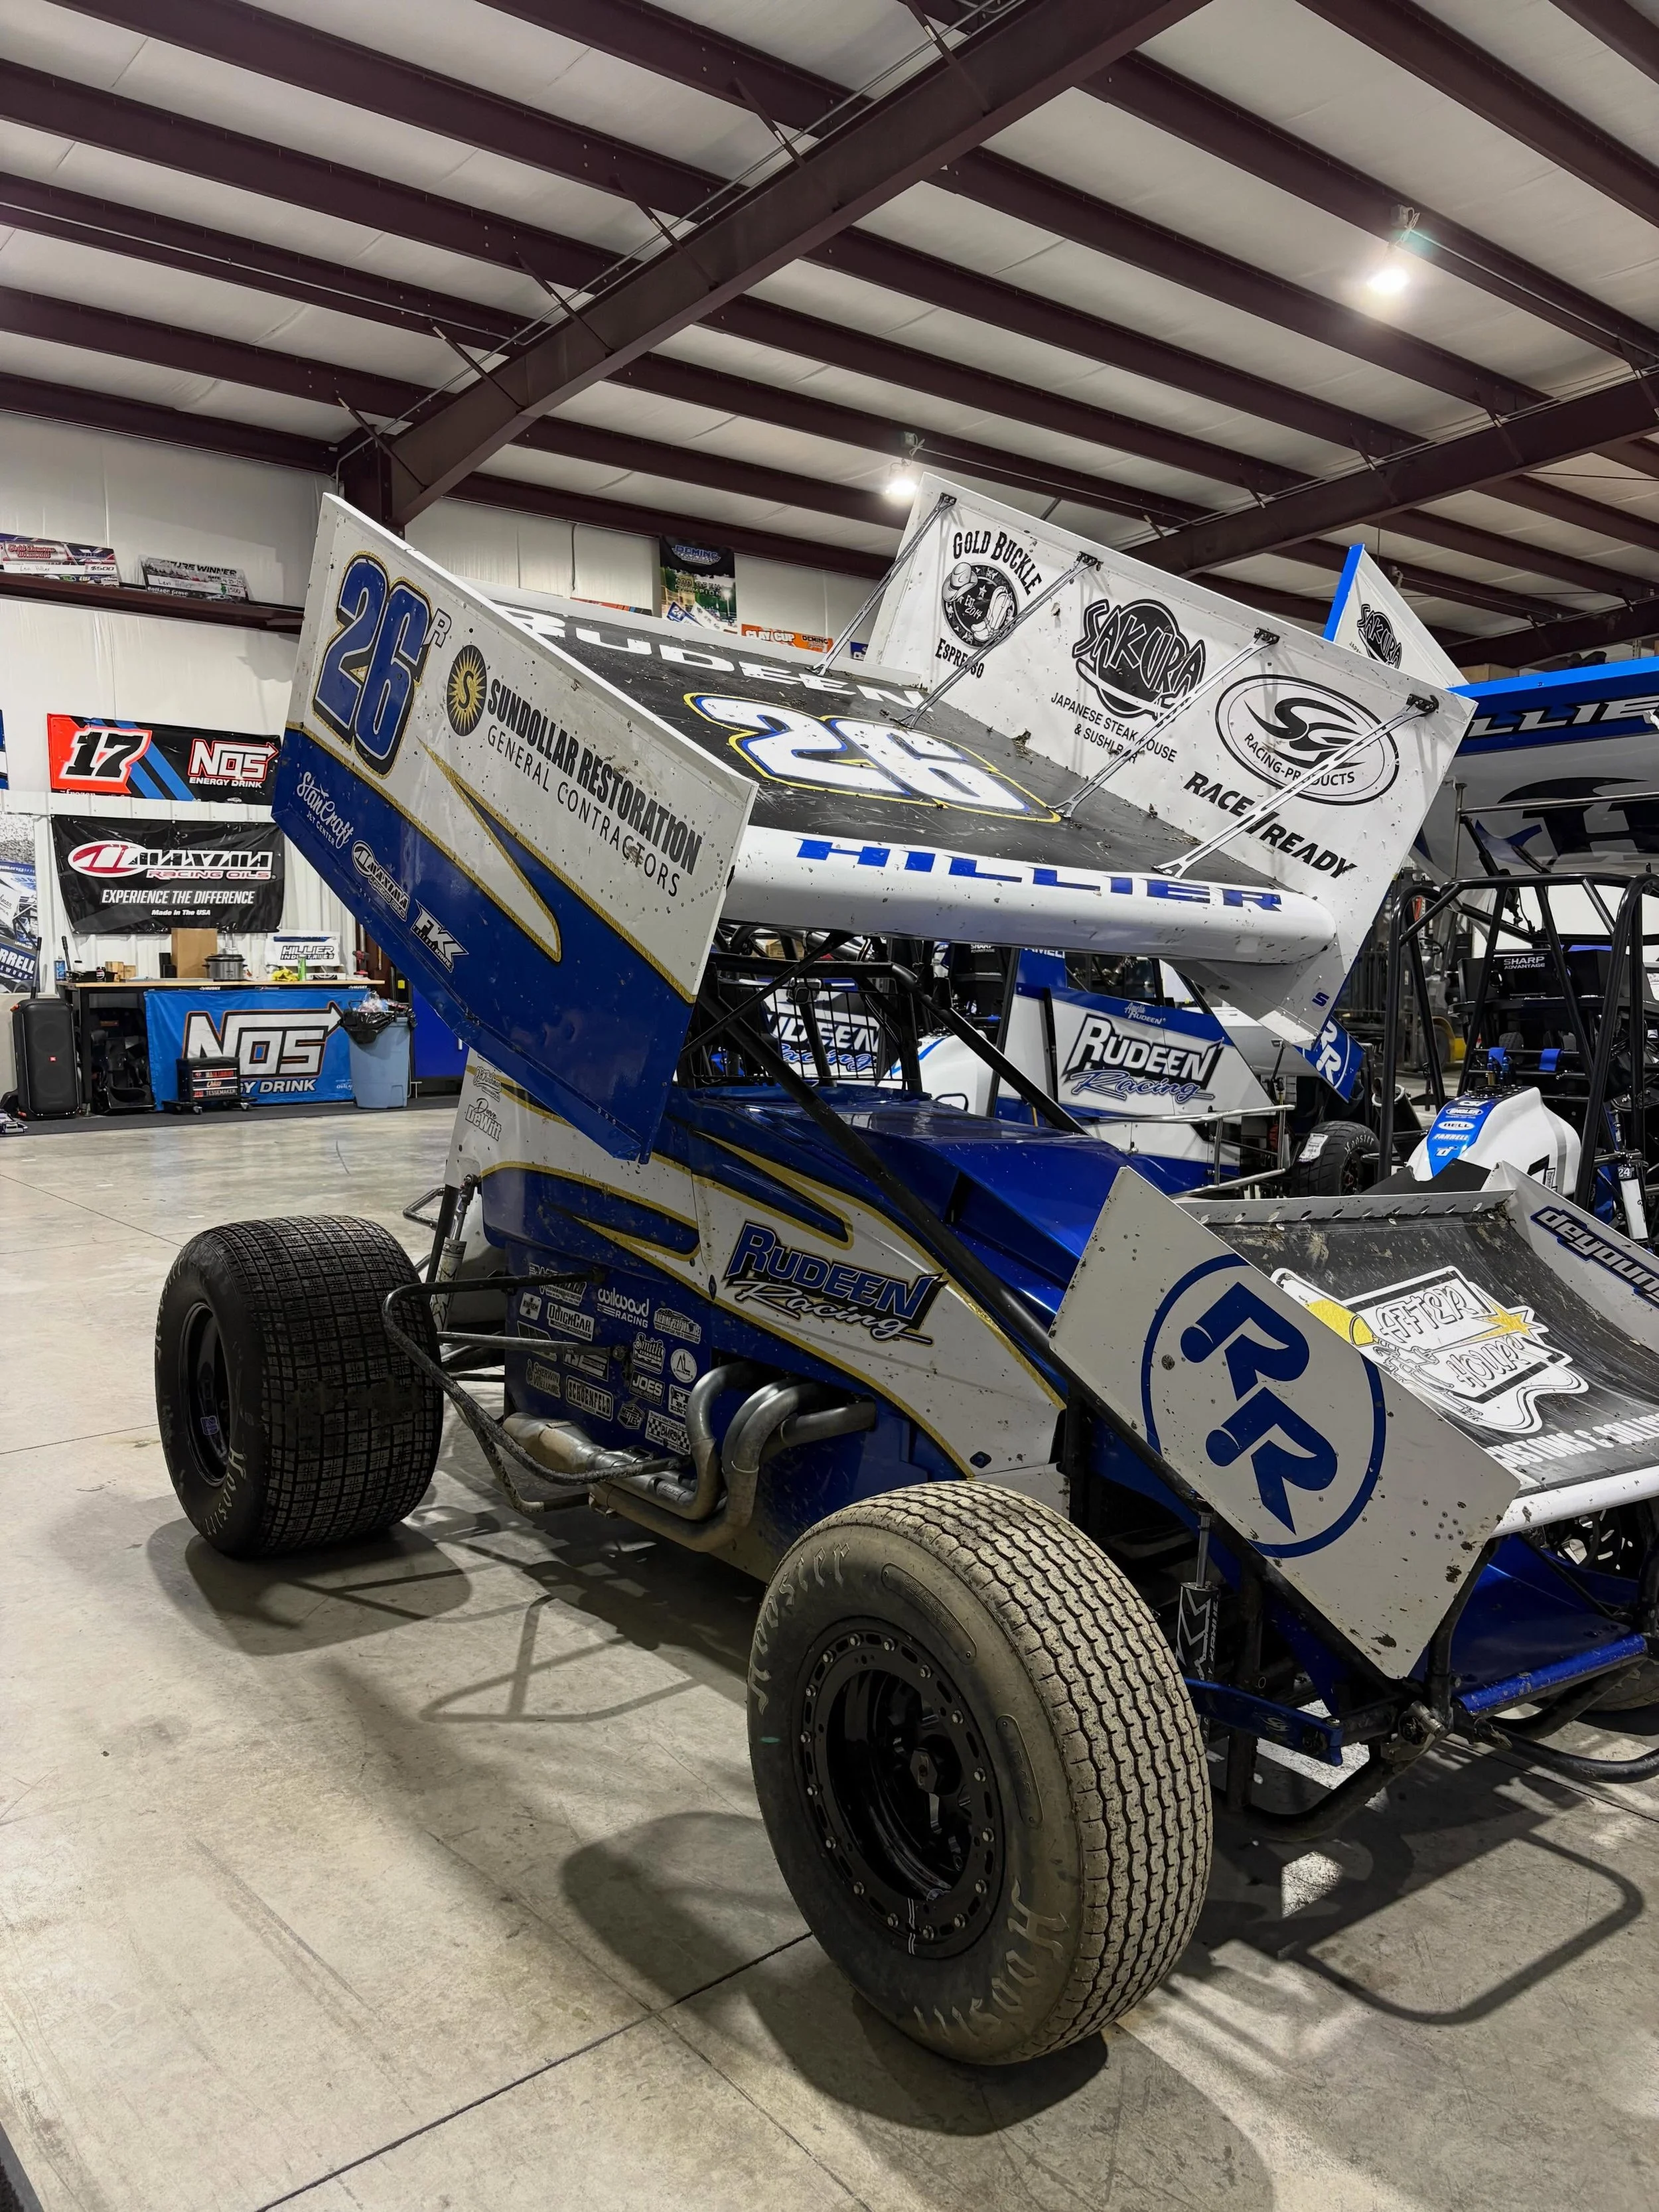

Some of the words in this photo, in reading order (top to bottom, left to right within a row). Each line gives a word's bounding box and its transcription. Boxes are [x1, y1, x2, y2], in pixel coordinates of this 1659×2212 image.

[953, 531, 991, 559] GOLD
[995, 532, 1043, 595] BUCKLE
[965, 607, 983, 619] 2014
[745, 630, 770, 641] CLAY
[774, 631, 795, 642] CUP
[1072, 599, 1205, 694] SAKURA
[1357, 604, 1402, 669] SAKURA
[313, 553, 431, 775] 26
[495, 603, 933, 711] RUDEEN
[935, 638, 984, 678] ESPRESO
[1051, 693, 1104, 725] JAPANESE
[1104, 717, 1177, 763] STEAKOUSE
[1074, 723, 1082, 735] &
[1084, 728, 1115, 751] SUSHI
[62, 728, 147, 779] 17
[190, 741, 278, 780] NOS
[691, 694, 1052, 820] 26
[190, 778, 230, 786] ENERGY
[232, 779, 262, 788] DRINK
[488, 680, 579, 778] SUNDOLLAR
[579, 747, 703, 874] RESTORATION
[297, 771, 354, 849] StanCraft
[488, 725, 549, 792] GENERAL
[557, 783, 680, 897] CONTRACTORS
[317, 821, 335, 846] CENTER
[129, 849, 273, 870] MAXIMA
[146, 869, 223, 880] RACING
[226, 870, 273, 880] OILS
[796, 838, 1283, 912] HILLIER
[102, 889, 168, 904] EXPERIENCE
[172, 890, 192, 904] THE
[194, 890, 255, 904] DIFFERENCE
[281, 945, 334, 954] HILLIER
[1503, 956, 1545, 965] SHARP
[767, 1013, 879, 1053] UDEEN
[1128, 1010, 1163, 1025] RUDEEN
[186, 1003, 342, 1076] NOS
[1062, 1014, 1223, 1083] RUDEEN
[259, 1079, 317, 1094] DRINK
[1070, 1069, 1215, 1104] Racing
[466, 1104, 502, 1142] DeWitt
[474, 1098, 498, 1120] Dave
[1618, 1165, 1632, 1179] 24
[724, 1220, 942, 1321] RUDEEN
[1534, 1208, 1659, 1305] deyoun
[598, 1287, 650, 1317] wilwood
[614, 1310, 649, 1329] RACING
[732, 1279, 934, 1345] Racing
[1376, 1286, 1479, 1343] AFTER
[633, 1333, 662, 1357] Smith
[534, 1363, 559, 1382] SHERWIN
[632, 1375, 663, 1397] JOES
[569, 1381, 611, 1414] SCHOENFELD
